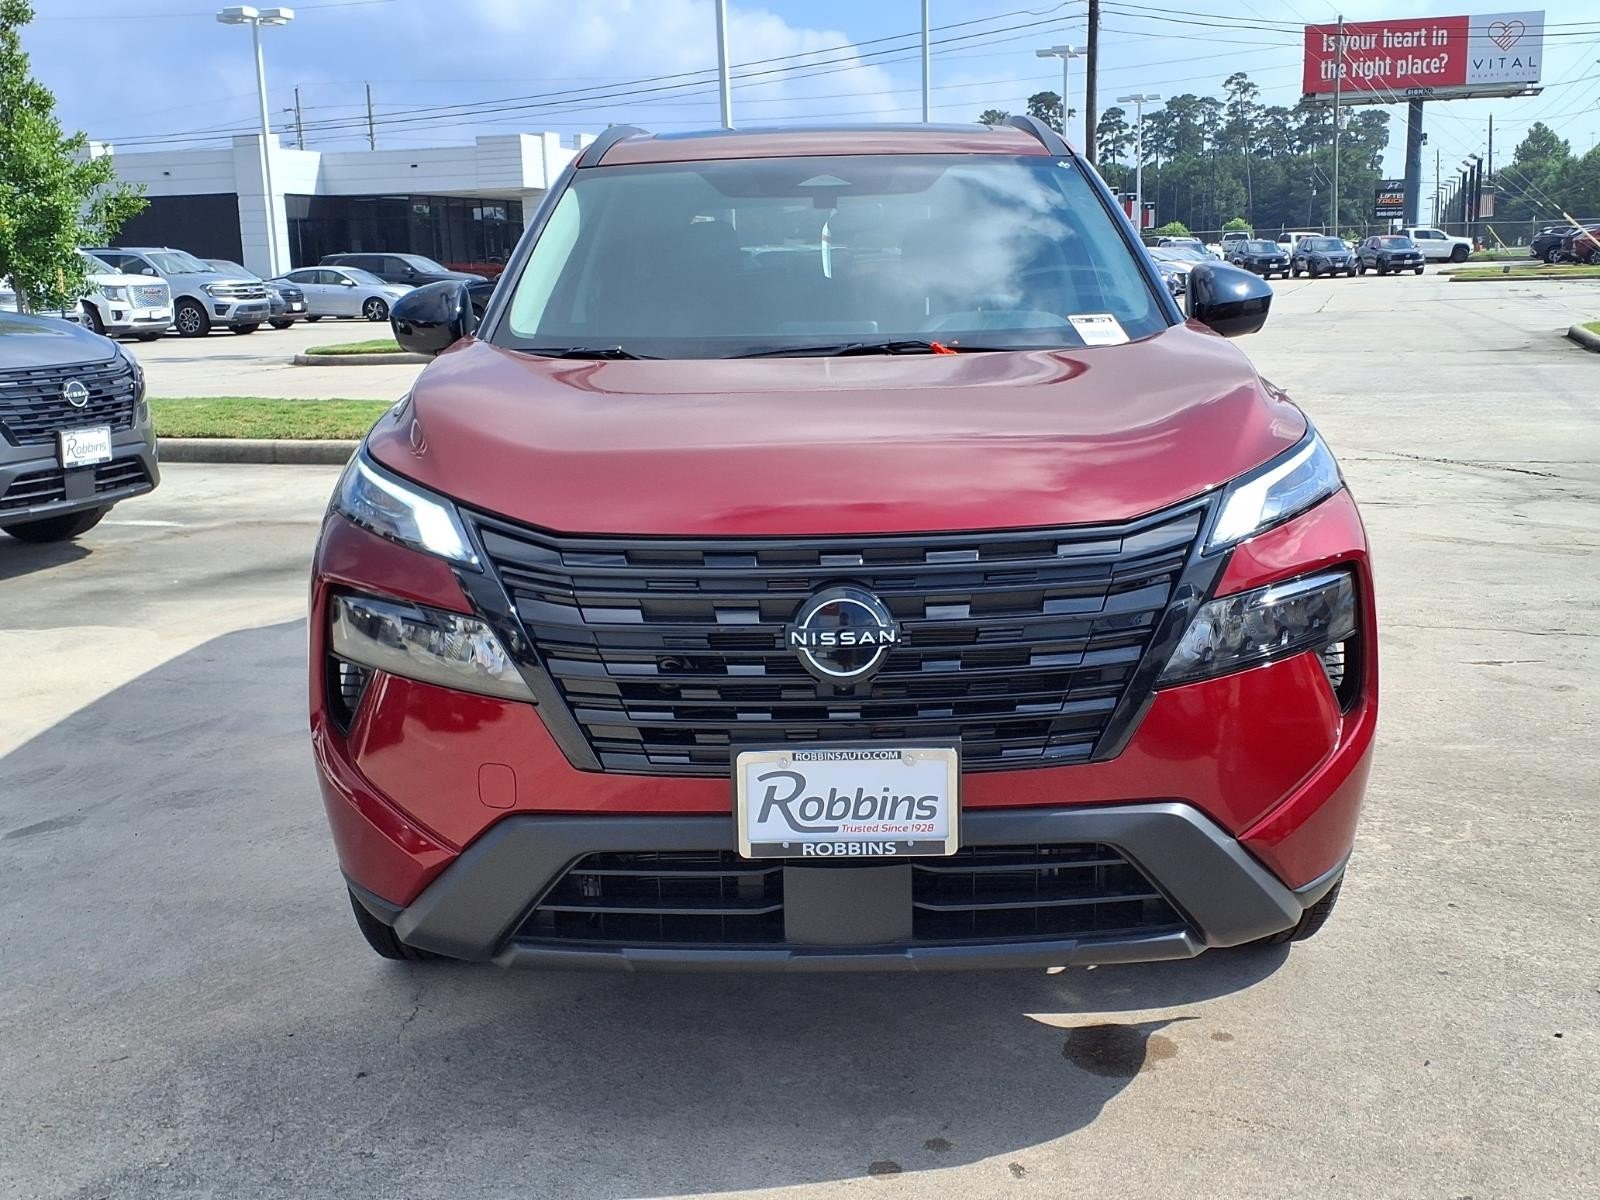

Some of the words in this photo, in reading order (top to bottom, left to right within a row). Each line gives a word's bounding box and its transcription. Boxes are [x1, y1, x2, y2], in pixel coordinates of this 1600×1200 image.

[1322, 34, 1336, 52] Is
[1340, 34, 1378, 53] your
[1383, 29, 1427, 48] heart
[1432, 26, 1448, 45] in
[1320, 59, 1347, 79] the
[1352, 56, 1392, 80] right
[1396, 53, 1449, 78] place?
[1472, 56, 1537, 70] VITAL
[65, 438, 107, 459] Robbins
[791, 629, 895, 645] NISSAN
[794, 751, 898, 762] ROBBINSAUTO.COM
[756, 770, 939, 833] Robbins
[841, 823, 879, 833] Trusted
[881, 823, 909, 833] Since
[911, 823, 934, 832] 1928
[802, 841, 897, 856] ROBBINS
